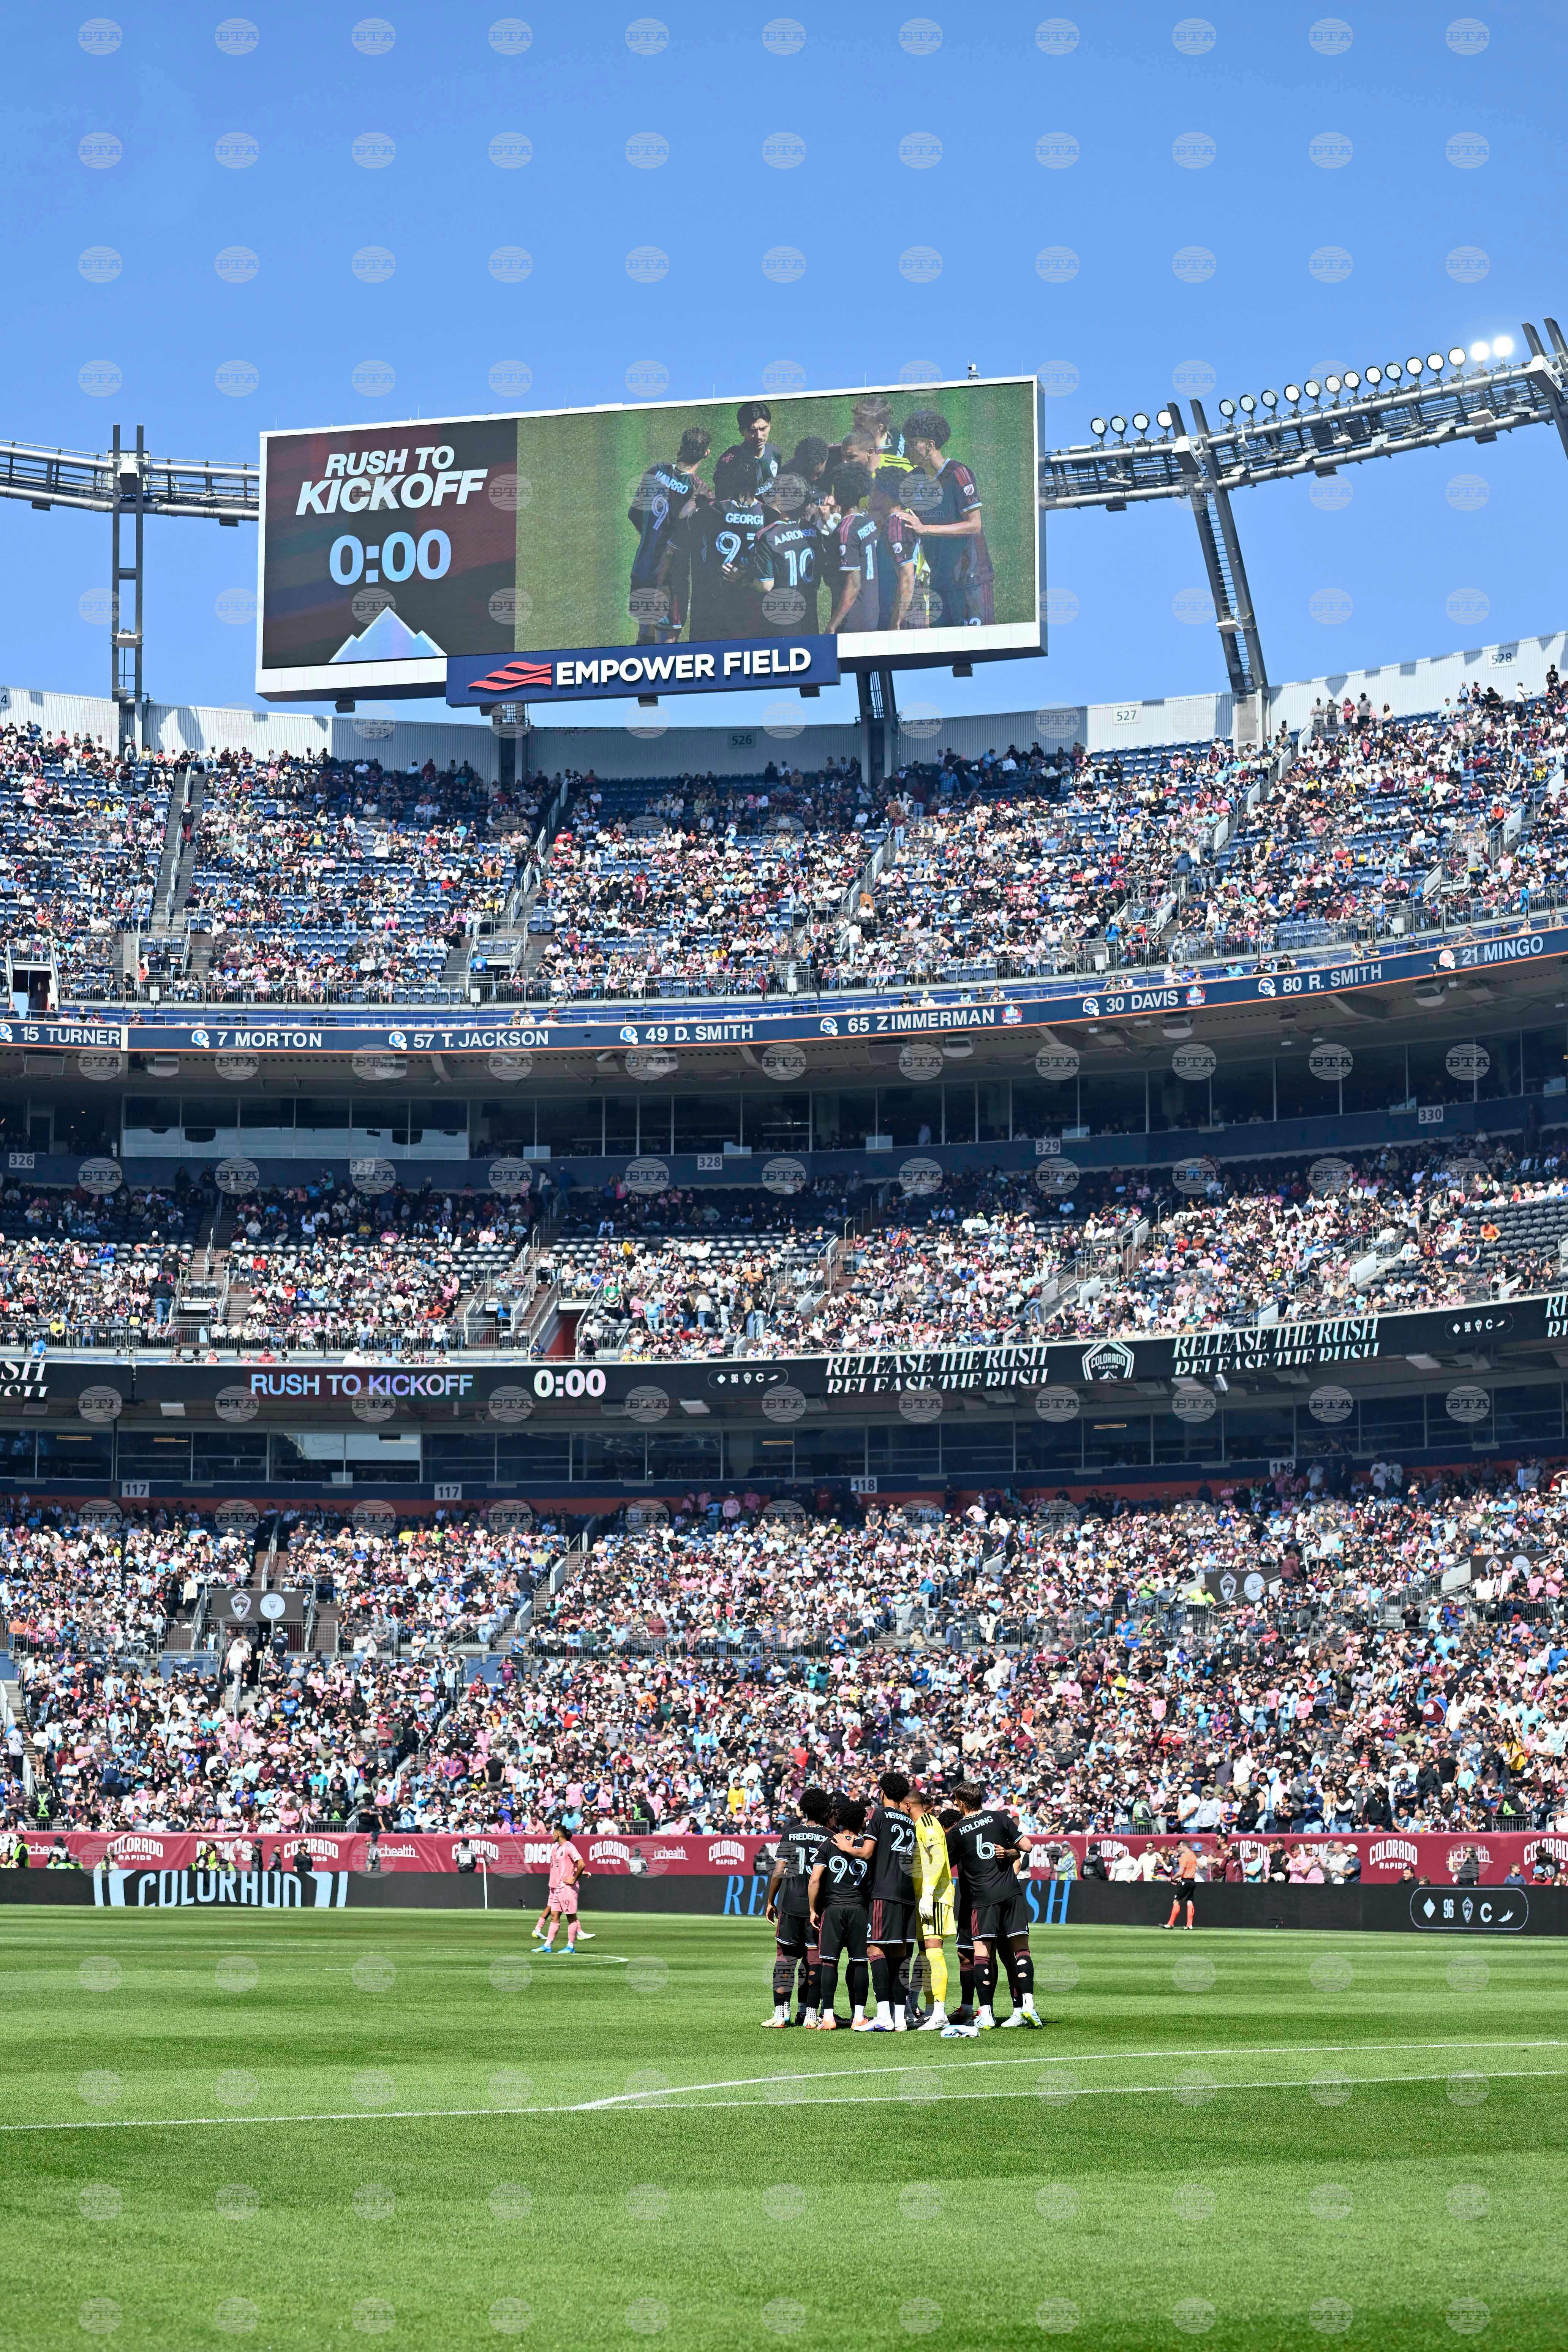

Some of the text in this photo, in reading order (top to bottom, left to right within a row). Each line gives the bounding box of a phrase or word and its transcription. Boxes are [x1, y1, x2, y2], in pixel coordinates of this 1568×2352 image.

[324, 446, 455, 477] RUSH TO
[296, 469, 488, 516] KICKOFF
[651, 494, 669, 530] 9
[725, 513, 764, 525] GEORGI
[329, 529, 452, 585] 0:00
[784, 547, 815, 586] 10
[556, 648, 811, 685] EMPOWER FIELD
[1491, 653, 1512, 665] 528
[1116, 710, 1137, 721] 527
[732, 735, 752, 746] 526
[1462, 936, 1544, 966] 21 MINGO
[1283, 964, 1382, 994] 80 R. SMITH
[1106, 990, 1179, 1013] 30 DAVIS
[848, 1008, 994, 1033] 65 ZIMMERMAN
[21, 1026, 120, 1045] 15 TURNER
[217, 1031, 322, 1048] 7 MORTON
[413, 1031, 549, 1049] 57 T. JACKSON
[645, 1024, 754, 1042] 49 D. SMITH
[1419, 1108, 1442, 1122] 330
[1036, 1140, 1060, 1154] 329
[10, 1154, 34, 1167] 326
[350, 1160, 374, 1174] 327
[698, 1156, 721, 1169] 328
[1172, 1318, 1379, 1358] RELEASE THE RUSH
[825, 1347, 1048, 1376] RELEASE THE RUSH
[1091, 1353, 1125, 1368] COLORADO
[251, 1374, 474, 1396] RUSH TO KICKOFF
[534, 1369, 606, 1398] 0:00
[125, 1484, 147, 1496] 117
[438, 1486, 459, 1498] 117
[854, 1479, 875, 1492] 118
[884, 1811, 915, 1826] HERRINGTO
[959, 1816, 994, 1835] HOLDING
[107, 1834, 163, 1858] COLORADO
[284, 1838, 339, 1859] COORADO
[589, 1840, 629, 1862] COLORADO
[654, 1846, 686, 1859] uchealth
[708, 1840, 745, 1862] COLORADO
[976, 1833, 996, 1860] 6
[1369, 1839, 1418, 1866] COLORADO
[828, 1855, 868, 1886] 99
[1443, 1899, 1492, 1923] 96 C
